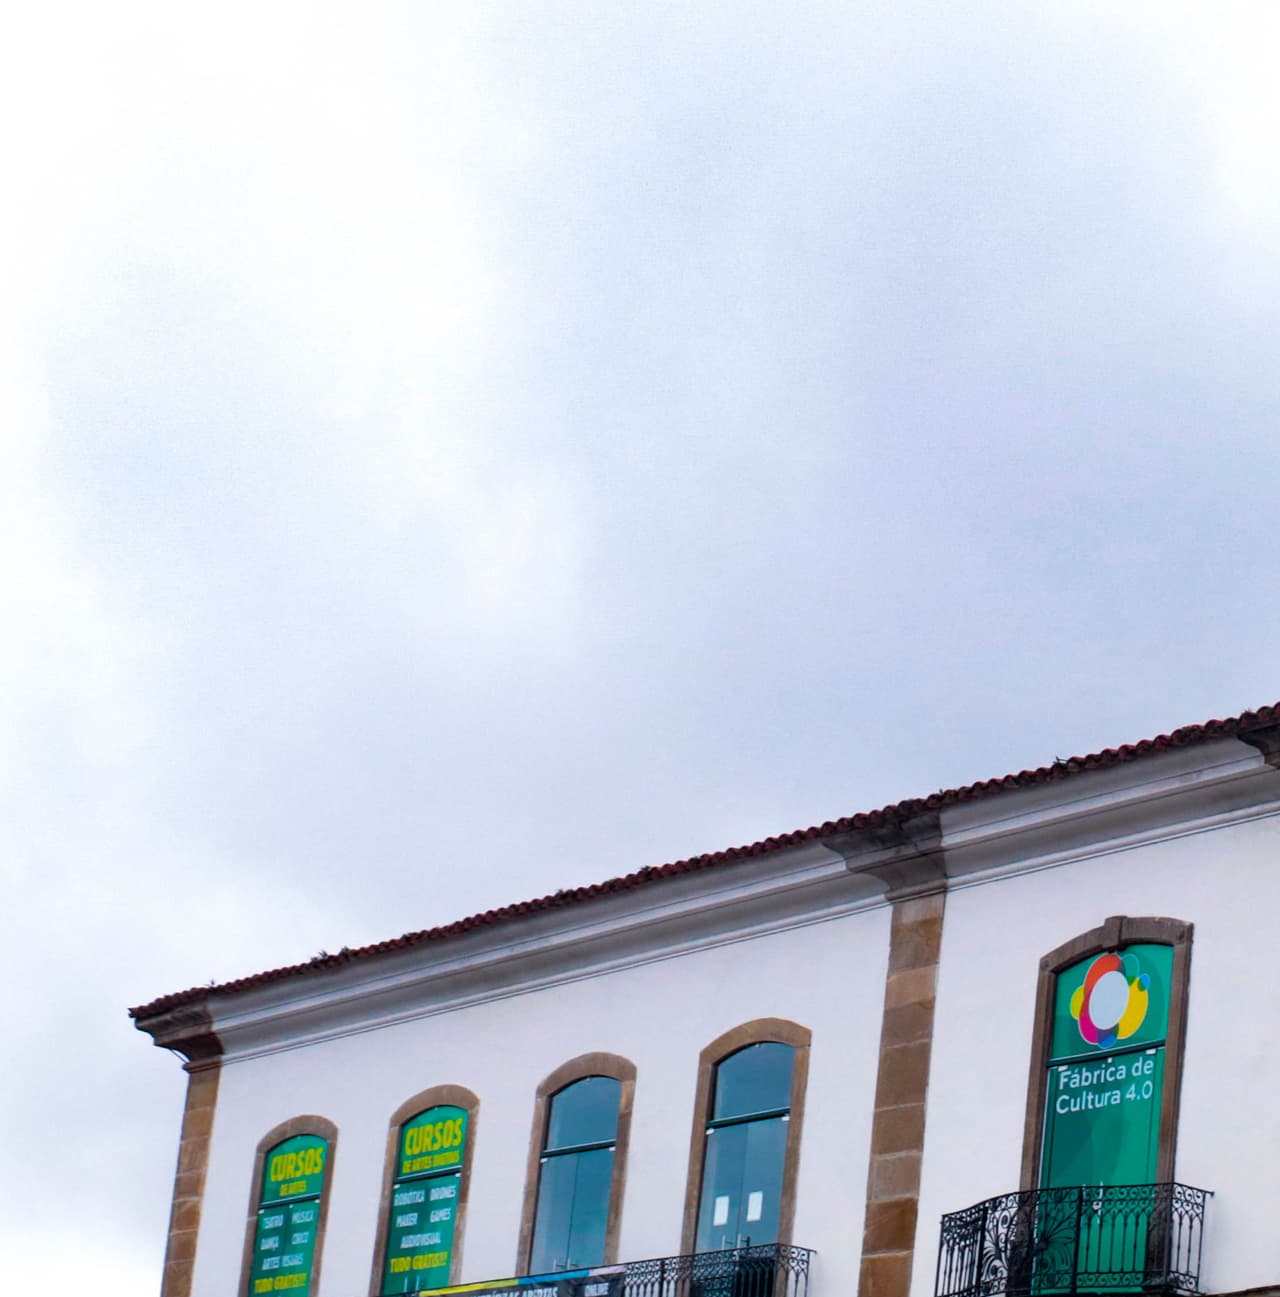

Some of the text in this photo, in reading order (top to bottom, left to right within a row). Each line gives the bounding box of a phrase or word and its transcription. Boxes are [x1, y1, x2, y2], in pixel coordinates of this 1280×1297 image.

[1058, 1057, 1154, 1090] Fábrica de
[1056, 1080, 1154, 1114] Cultura 4.0
[405, 1118, 463, 1155] CURSOS
[270, 1147, 324, 1182] CURSOS
